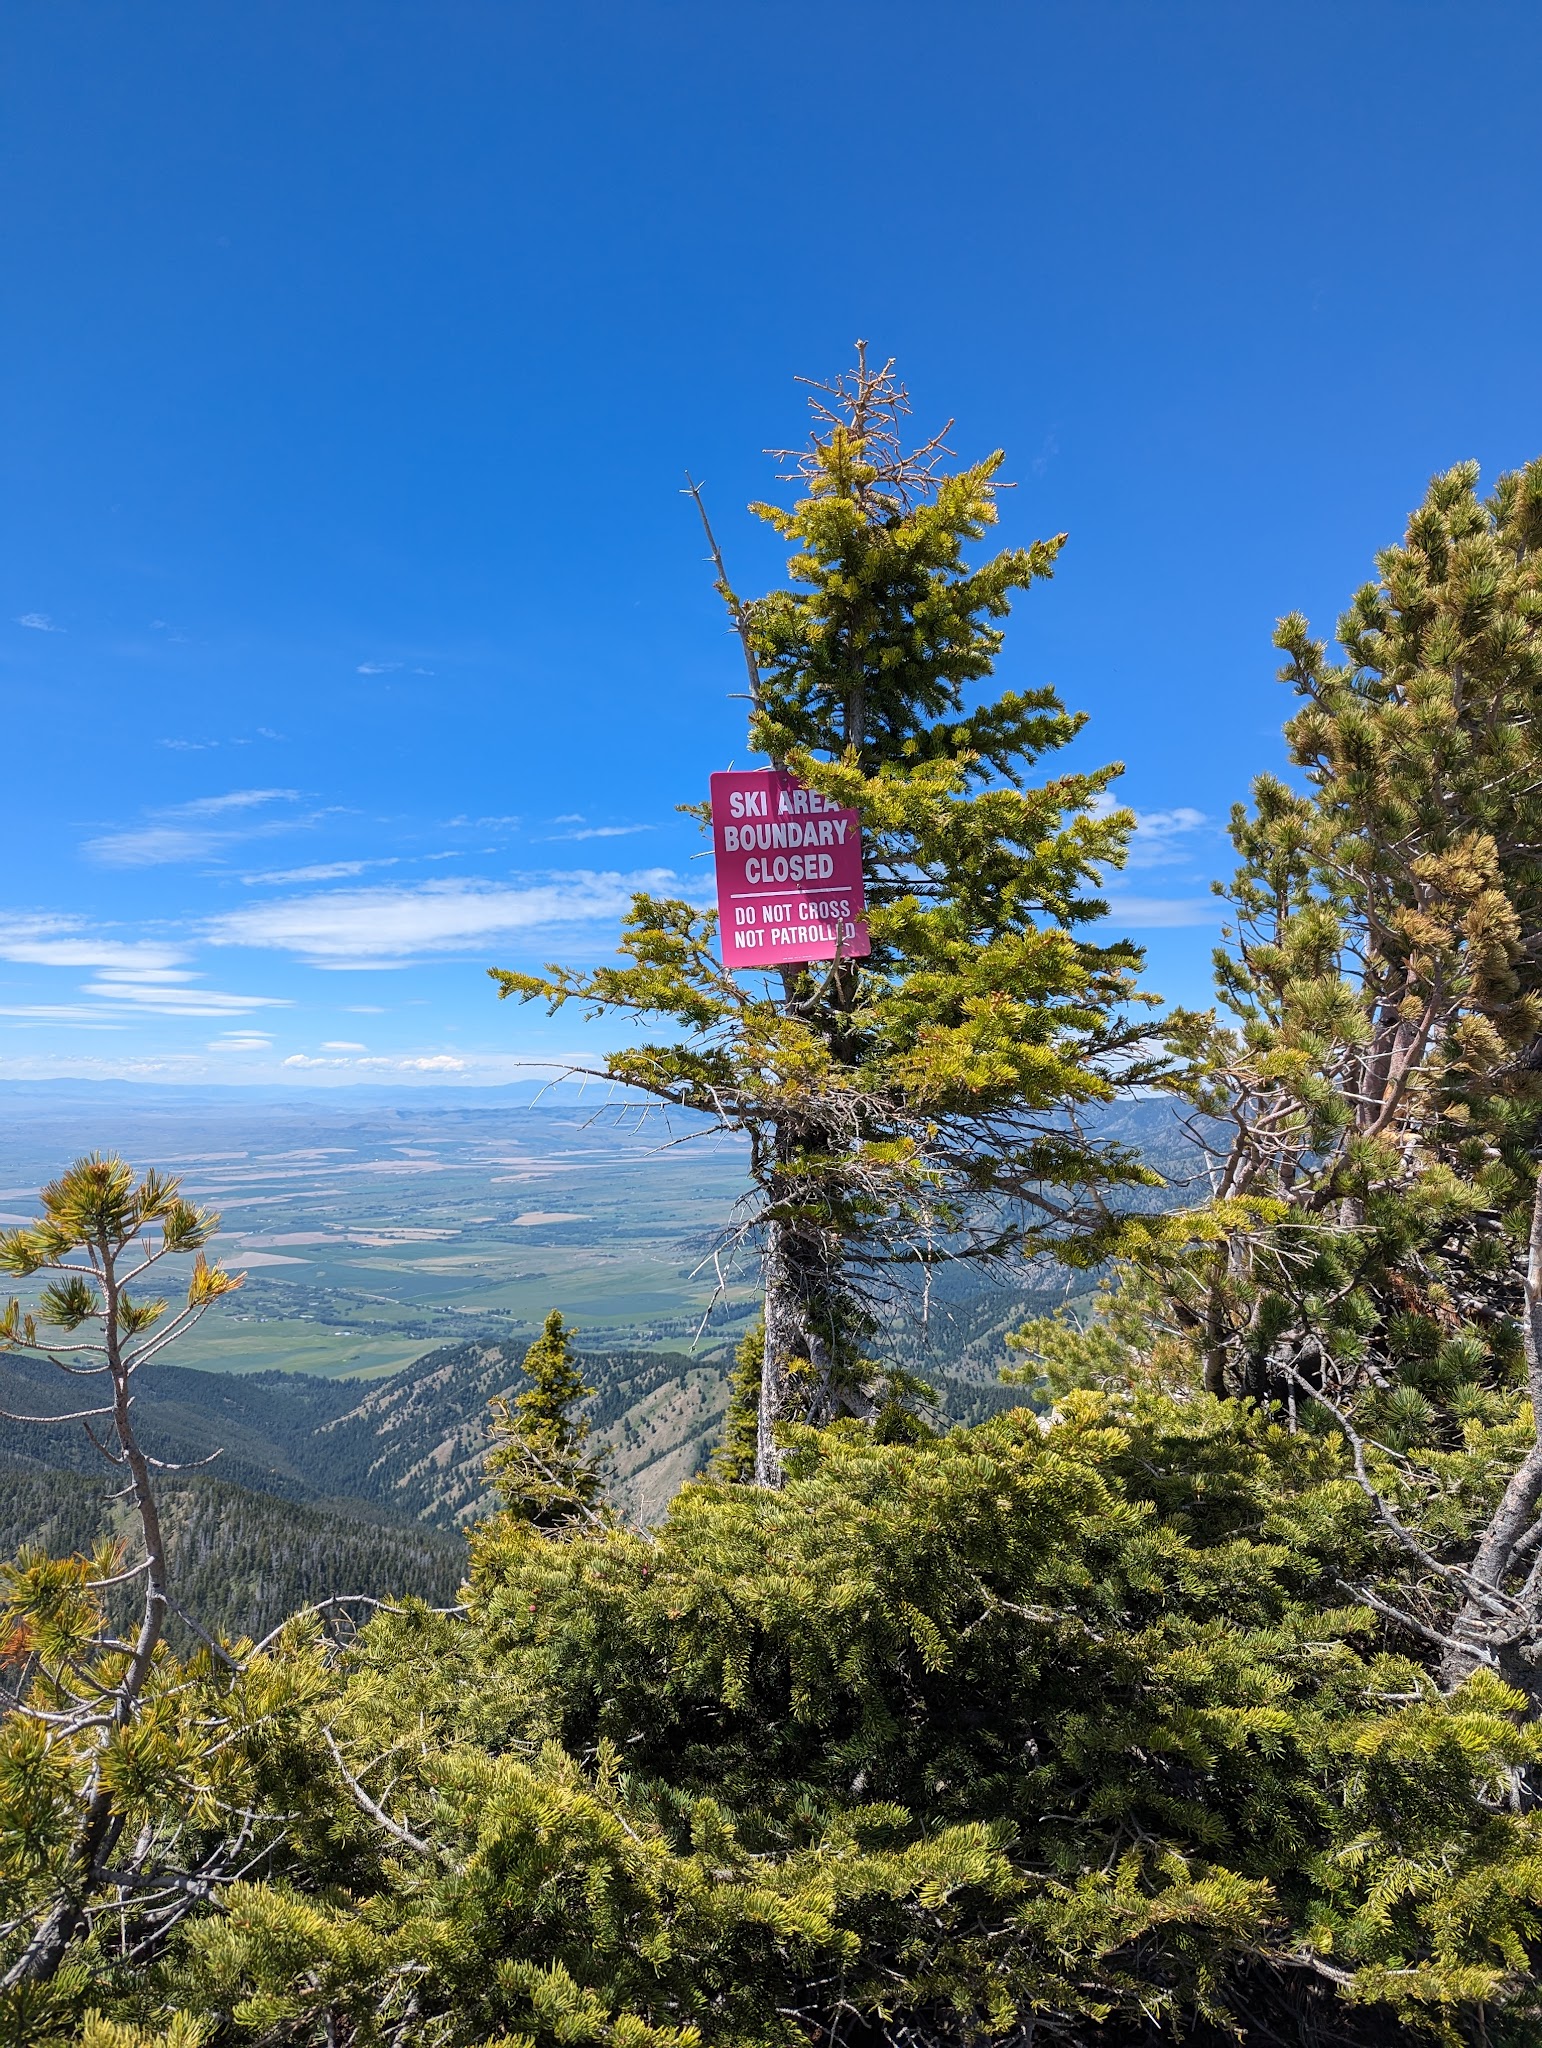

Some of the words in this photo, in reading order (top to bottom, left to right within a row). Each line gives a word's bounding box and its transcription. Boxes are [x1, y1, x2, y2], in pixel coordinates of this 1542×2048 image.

[730, 791, 767, 818] SKI
[724, 819, 848, 852] BOUNDARY
[745, 854, 833, 884] CLOSED
[735, 907, 756, 925] DO
[763, 904, 792, 923] NOT
[799, 900, 850, 921] CROSS
[735, 929, 764, 948] NOT
